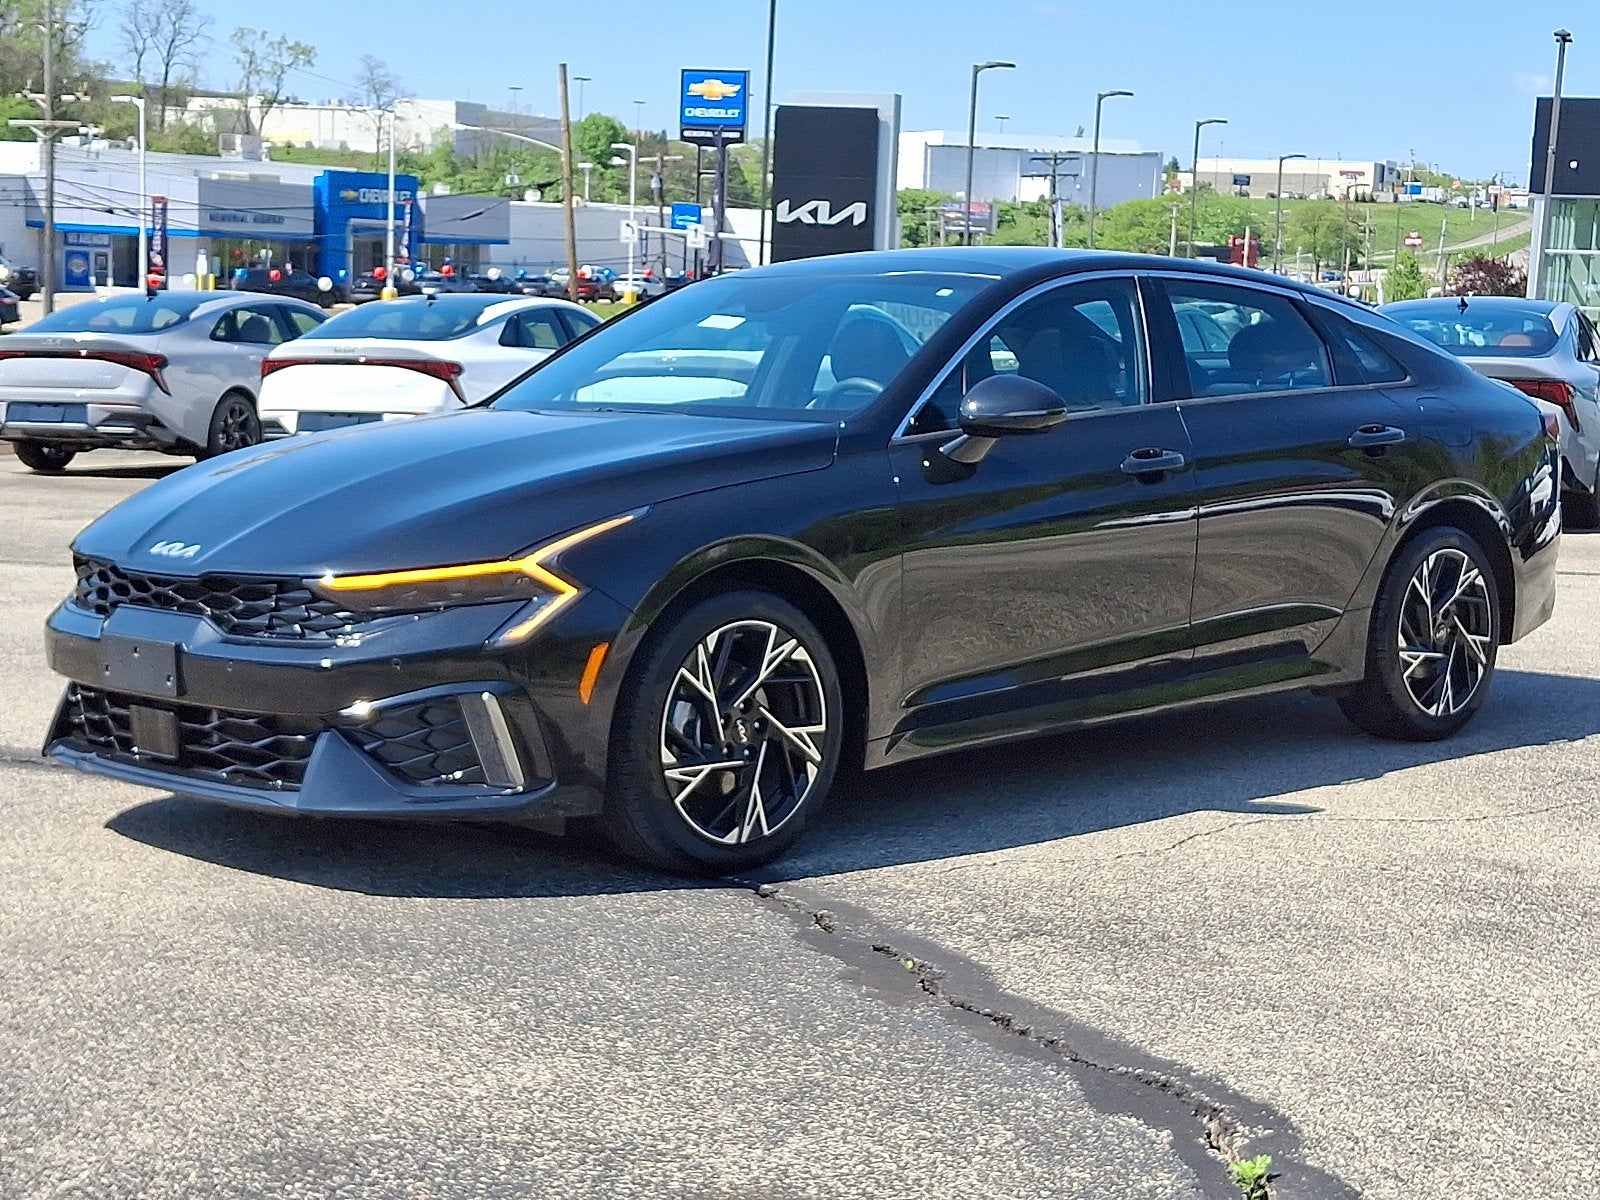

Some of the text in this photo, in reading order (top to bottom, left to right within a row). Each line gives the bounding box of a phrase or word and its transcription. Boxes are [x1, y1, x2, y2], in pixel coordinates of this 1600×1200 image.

[358, 188, 412, 204] CHEVRLET
[776, 199, 867, 226] KIA
[149, 539, 201, 559] KIA
